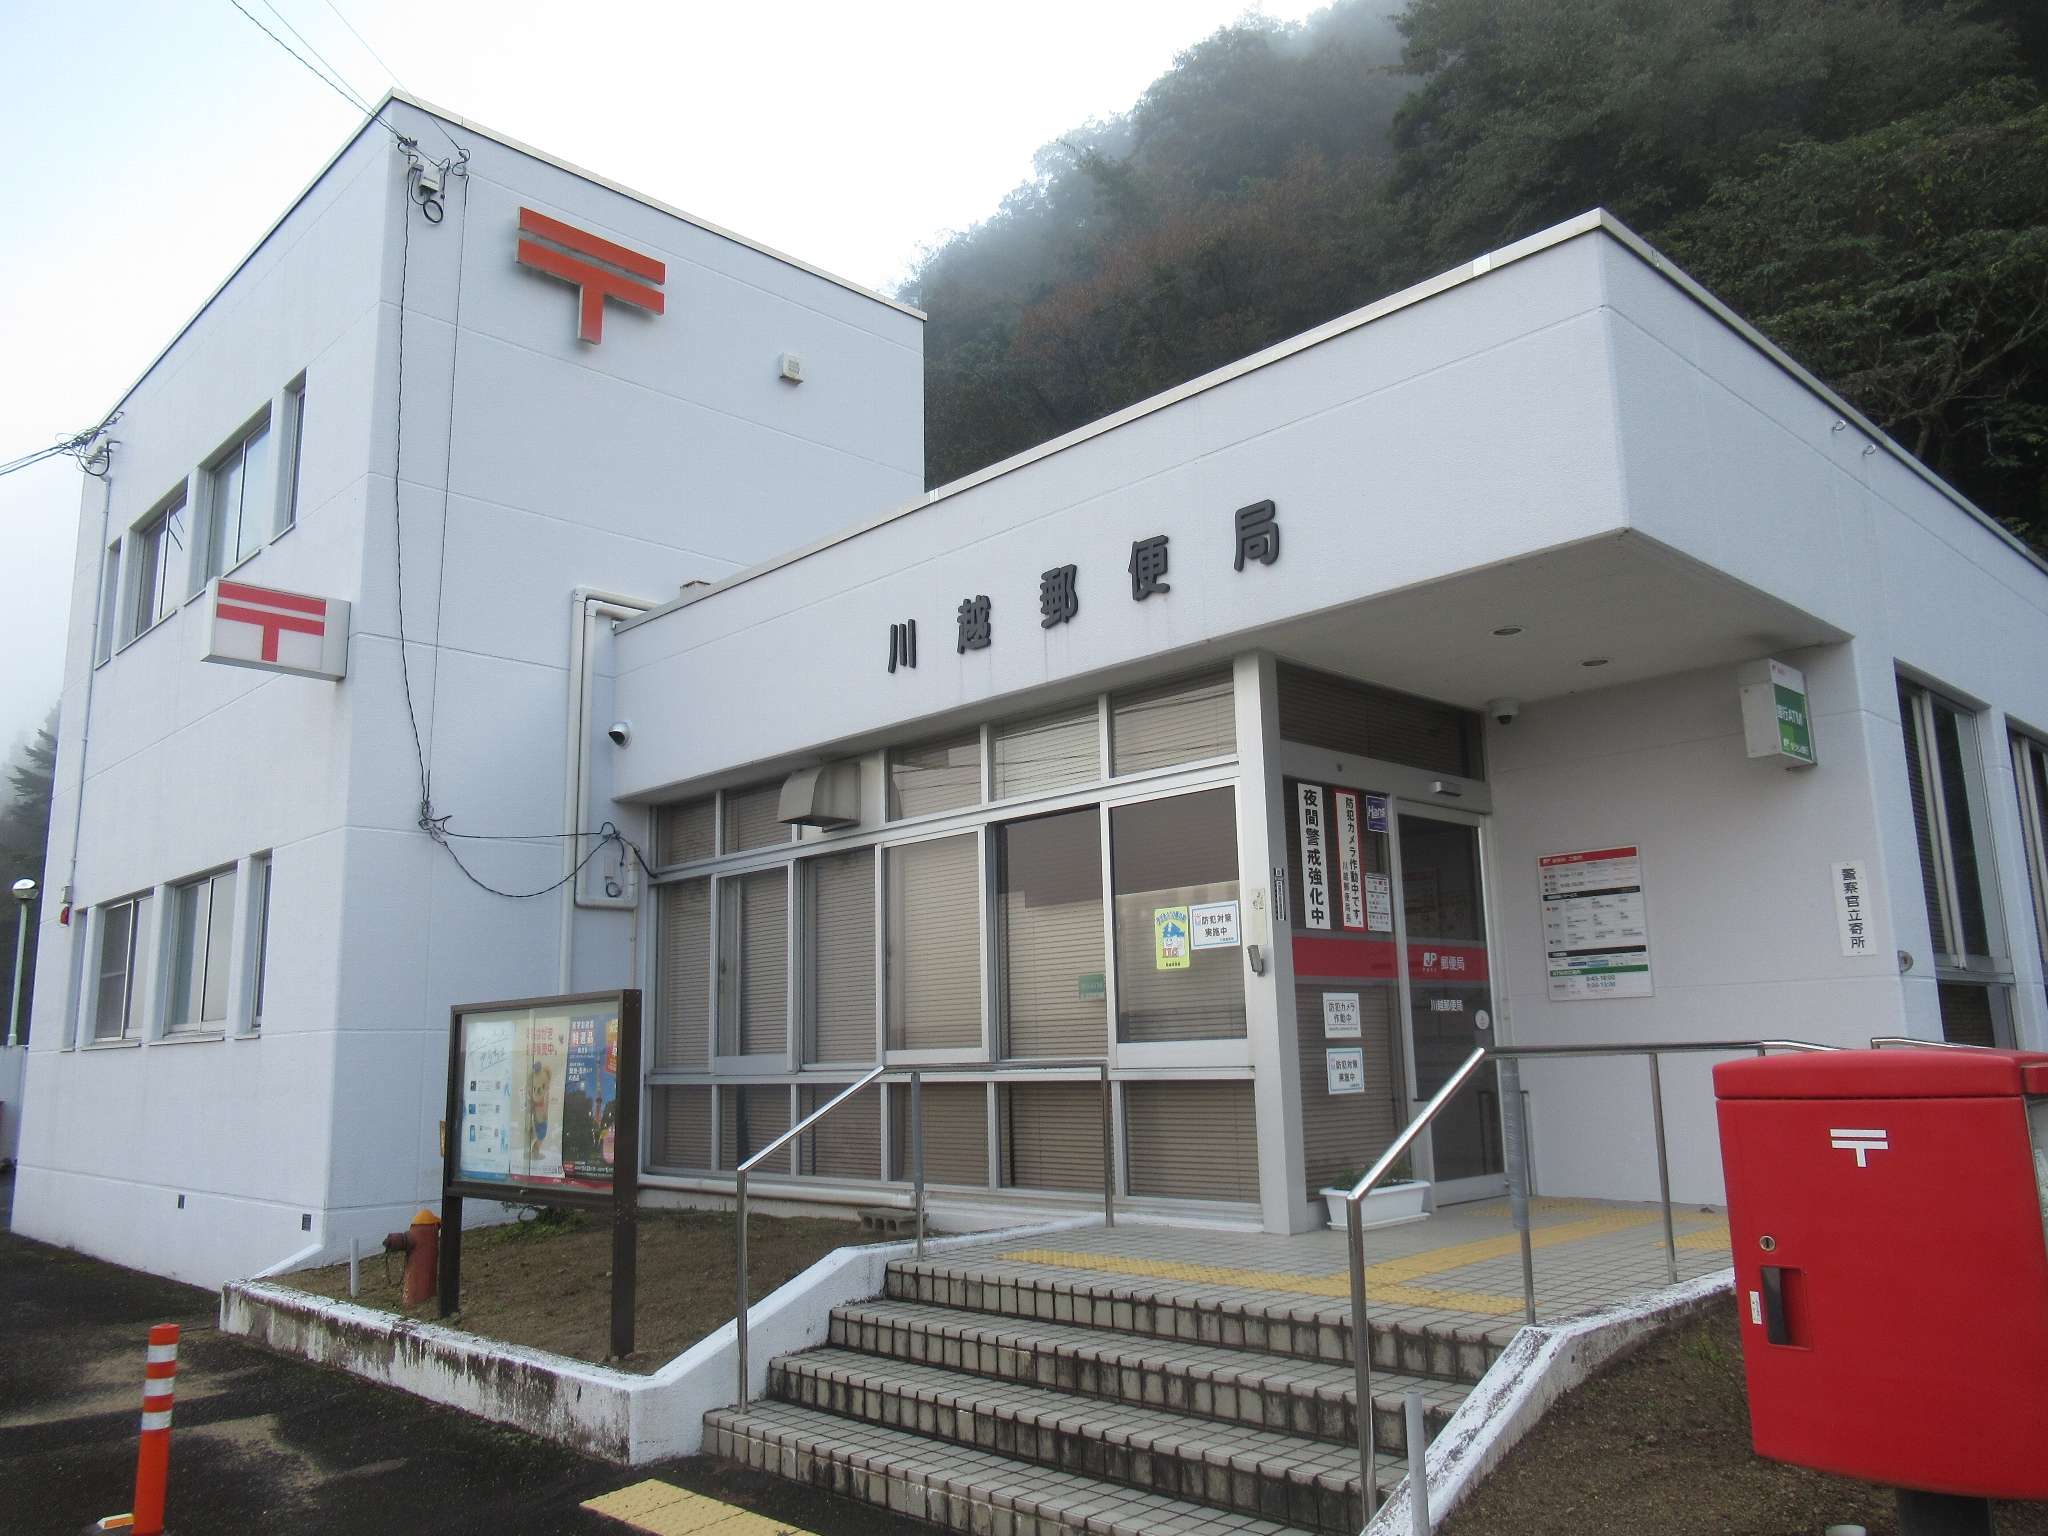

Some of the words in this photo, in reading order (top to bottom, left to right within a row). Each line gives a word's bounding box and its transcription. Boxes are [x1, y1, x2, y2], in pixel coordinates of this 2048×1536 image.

[888, 499, 1280, 673] 川越郵便局
[1303, 789, 1325, 925] 夜間警戒強化中
[1201, 913, 1233, 926] 防犯対策
[1204, 927, 1228, 937] 実施中
[1328, 1000, 1355, 1012] 防犯カメラ
